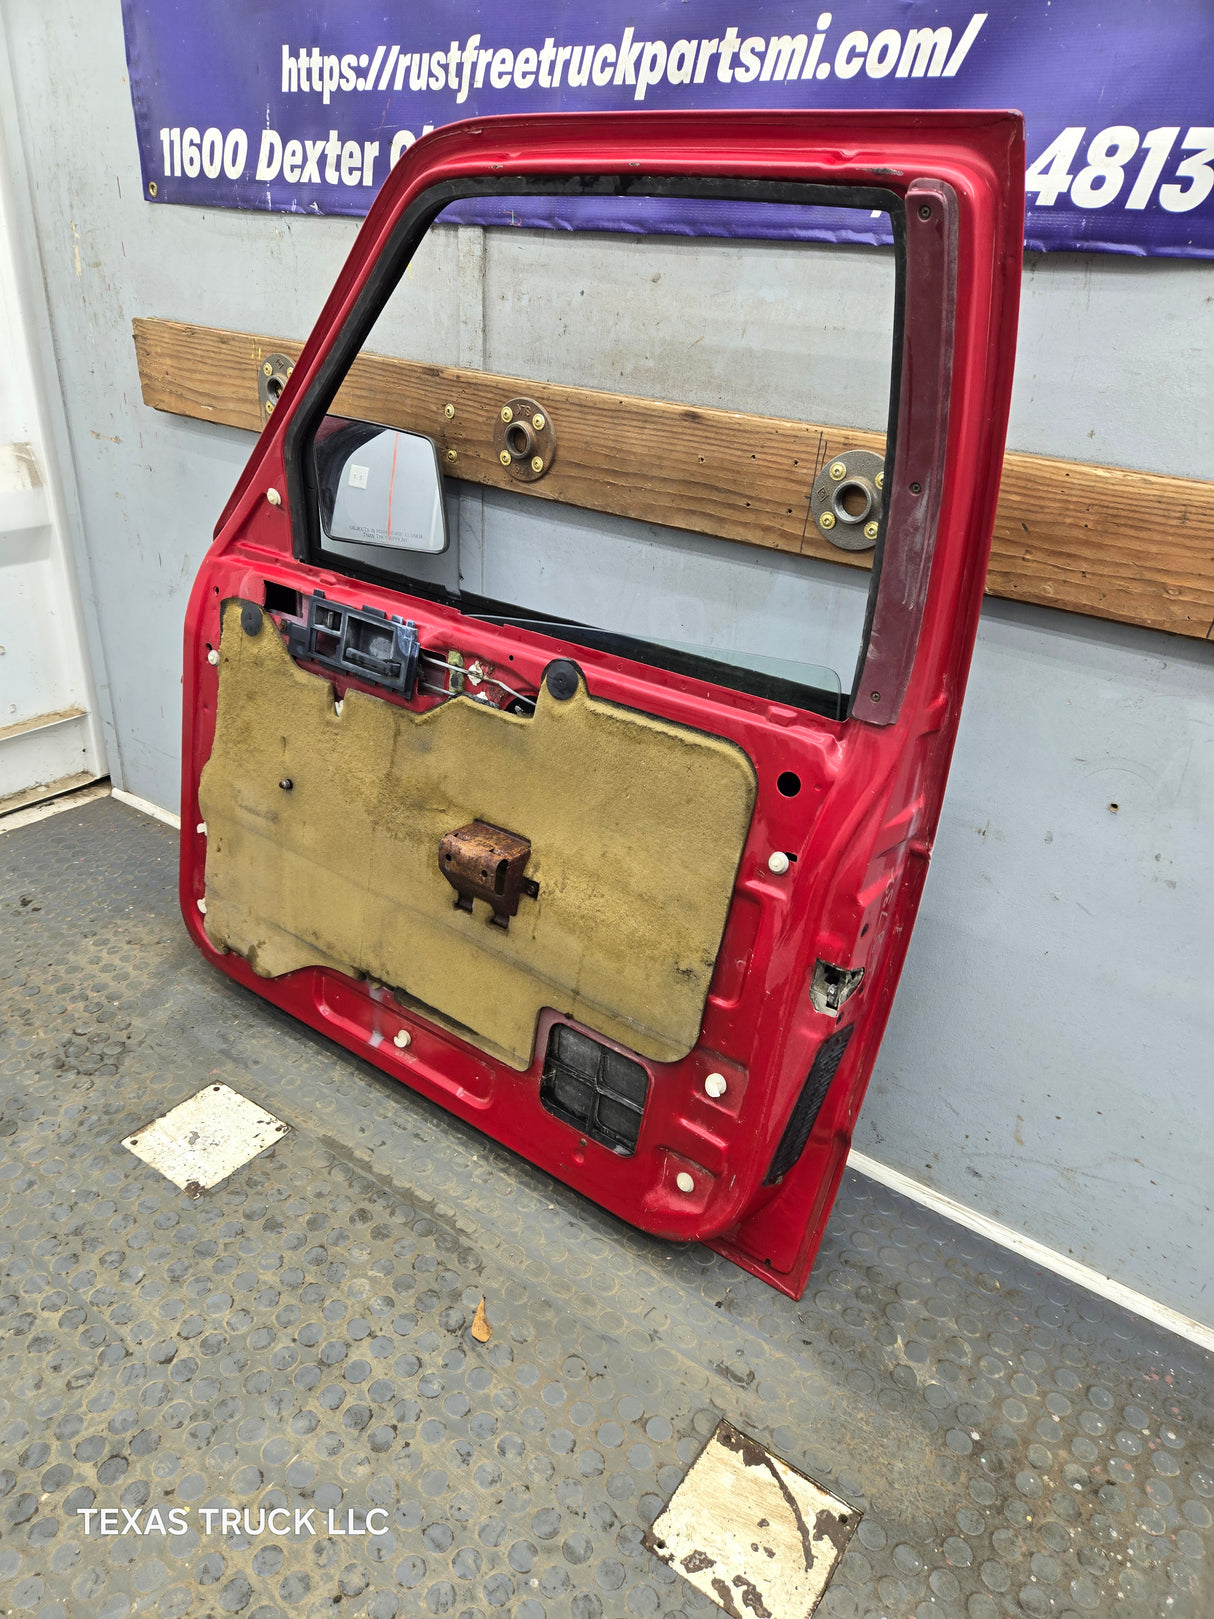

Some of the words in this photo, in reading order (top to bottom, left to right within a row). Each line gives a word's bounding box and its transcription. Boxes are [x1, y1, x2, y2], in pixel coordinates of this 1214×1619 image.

[281, 12, 988, 105] https://rustfreetruckpartsmi.com/
[159, 127, 248, 180] 11600
[255, 129, 379, 187] Dexter
